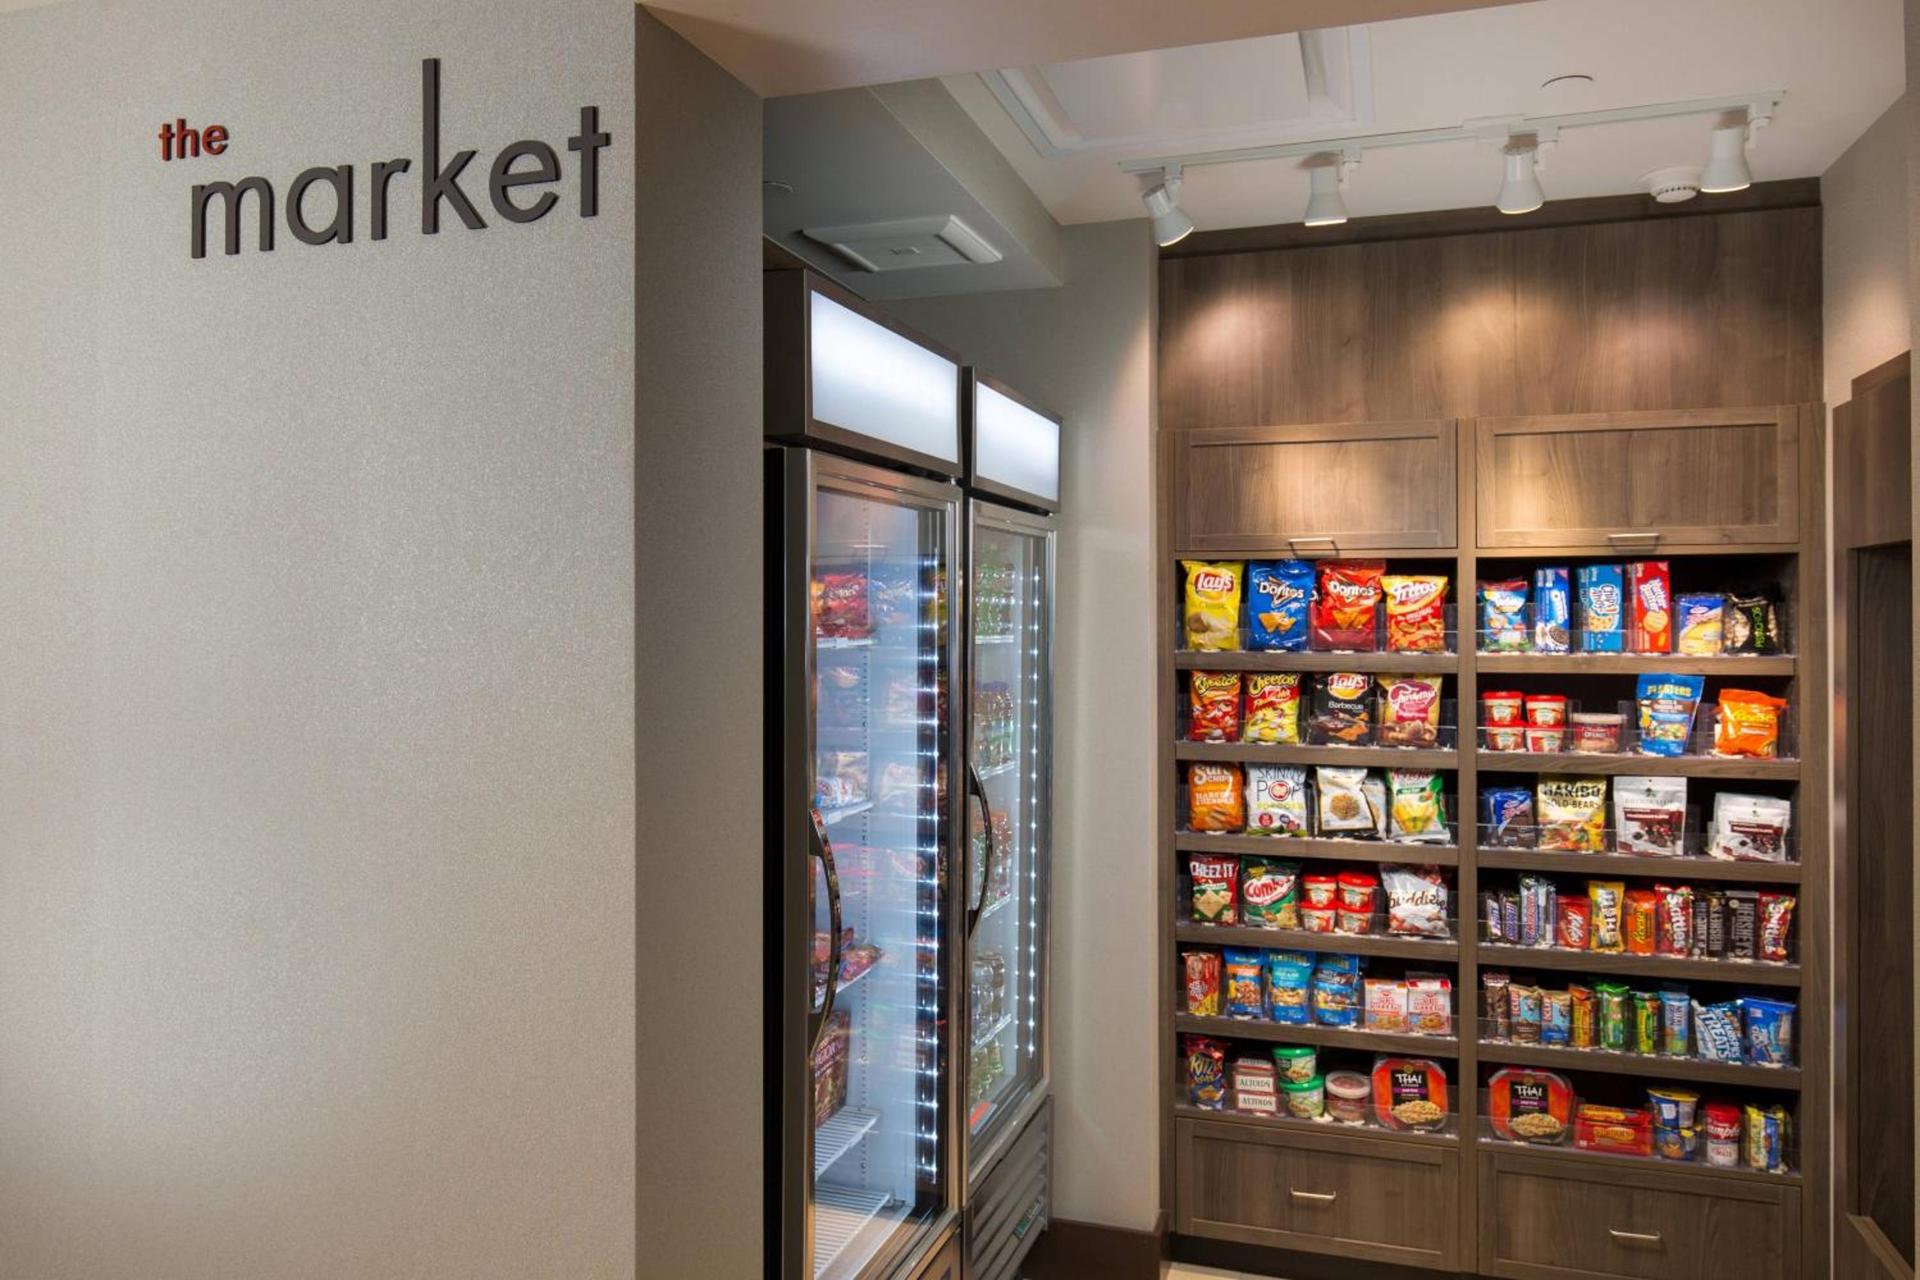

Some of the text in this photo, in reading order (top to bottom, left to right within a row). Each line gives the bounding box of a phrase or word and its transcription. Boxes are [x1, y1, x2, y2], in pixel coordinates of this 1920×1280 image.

[159, 119, 229, 161] the
[191, 58, 612, 259] market
[1259, 582, 1304, 599] Doritos
[1328, 580, 1375, 597] Doritos
[1393, 582, 1436, 604] Fritos
[1250, 674, 1296, 694] Cheetos
[1328, 701, 1364, 711] Barbecue
[1666, 893, 1687, 950] Skittles
[1735, 902, 1755, 957] HERSHEY'S
[1764, 902, 1784, 954] Skittles
[1697, 1013, 1732, 1060] TREATS
[1395, 1073, 1422, 1085] THAI
[1514, 1085, 1542, 1097] THAI
